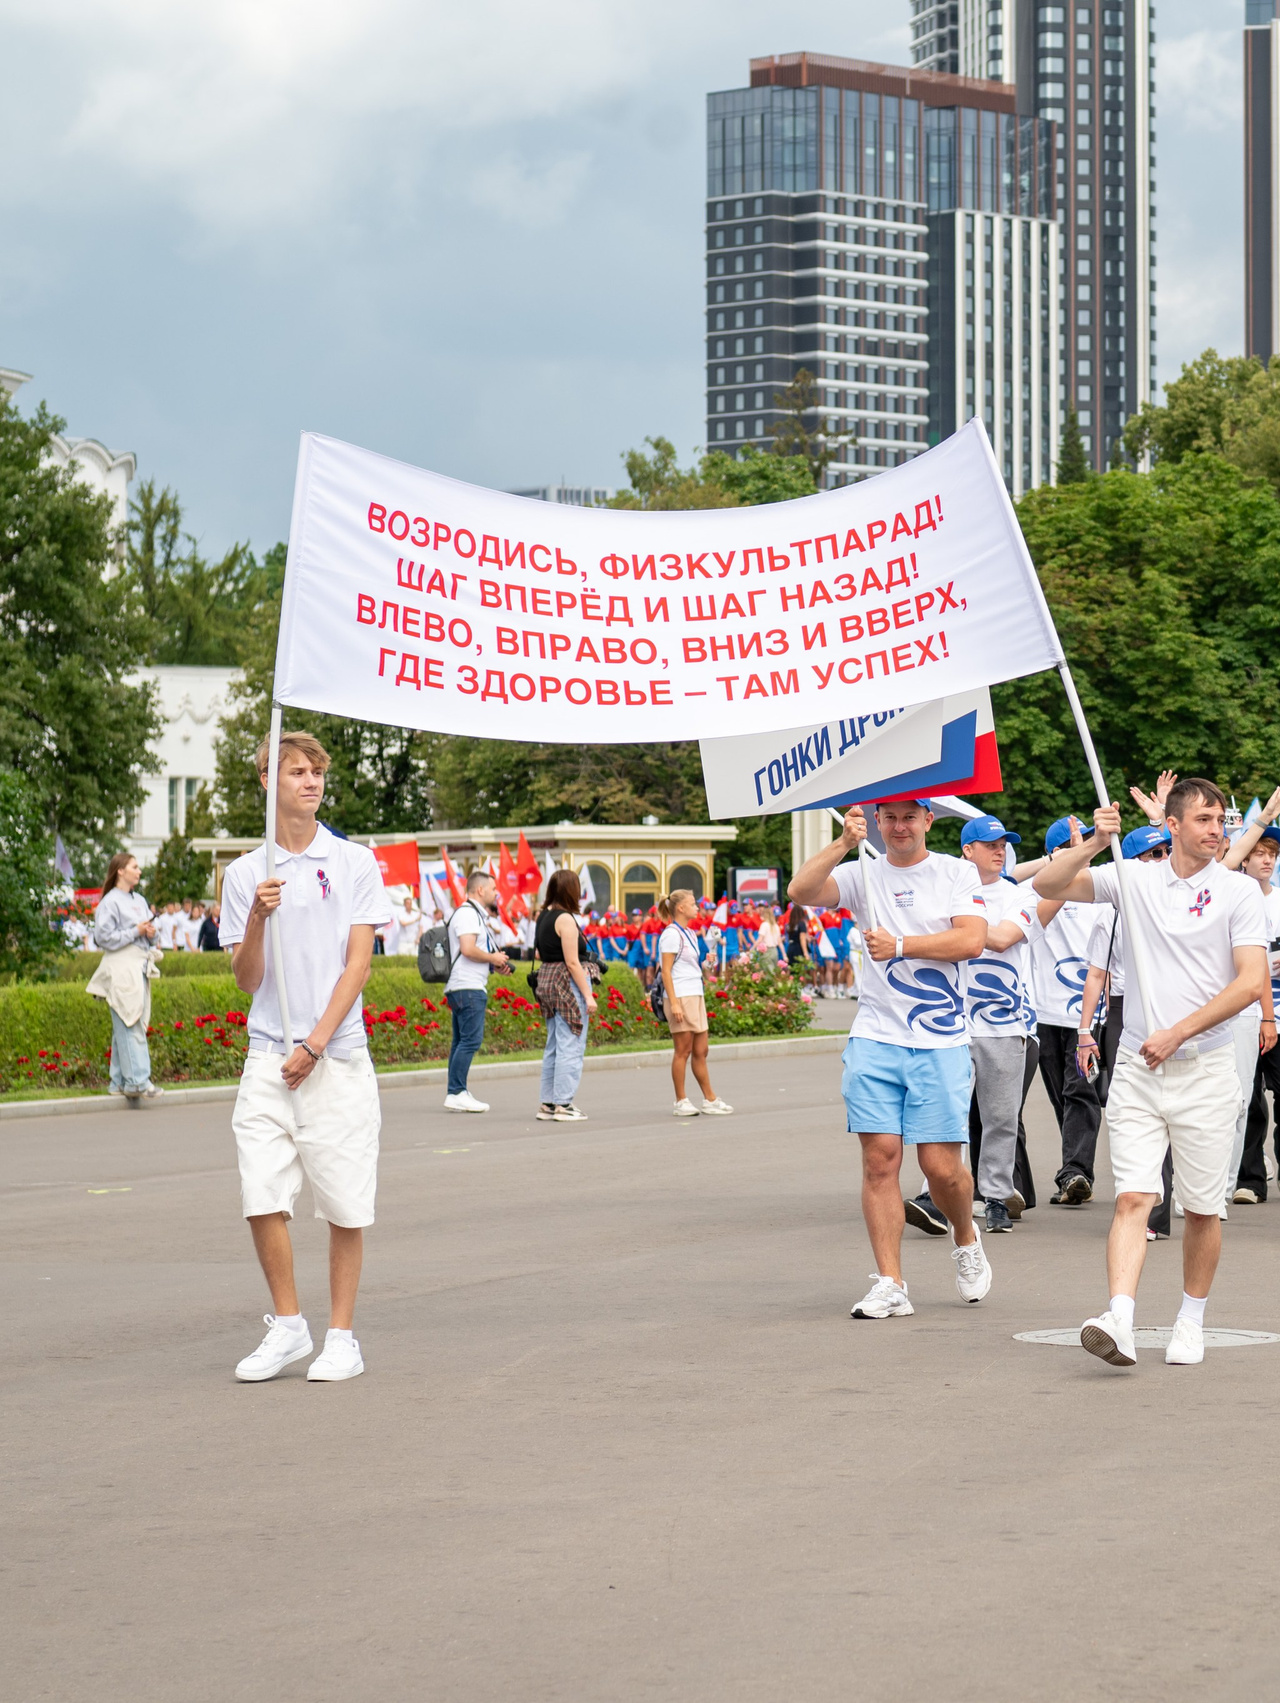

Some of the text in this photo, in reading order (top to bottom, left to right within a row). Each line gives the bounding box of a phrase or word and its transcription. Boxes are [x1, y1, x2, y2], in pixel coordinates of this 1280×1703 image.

[368, 495, 943, 581] ВОЗРОДИСЬ, ФИЗКУЛЬТПАРАД!
[357, 582, 966, 668] ВЛЕВО, ВПРАВО, ВНИЗ И ВВЕРХ,
[397, 553, 918, 627] ШАГ ВПЕРЁД И ШАГ НАЗАД!
[379, 648, 444, 690] ГДЕ
[457, 665, 673, 706] ЗДОРОВЬЕ
[716, 669, 799, 701] ТАМ
[812, 631, 949, 689] УСПЕХ!
[754, 725, 832, 806] ГОНКИ
